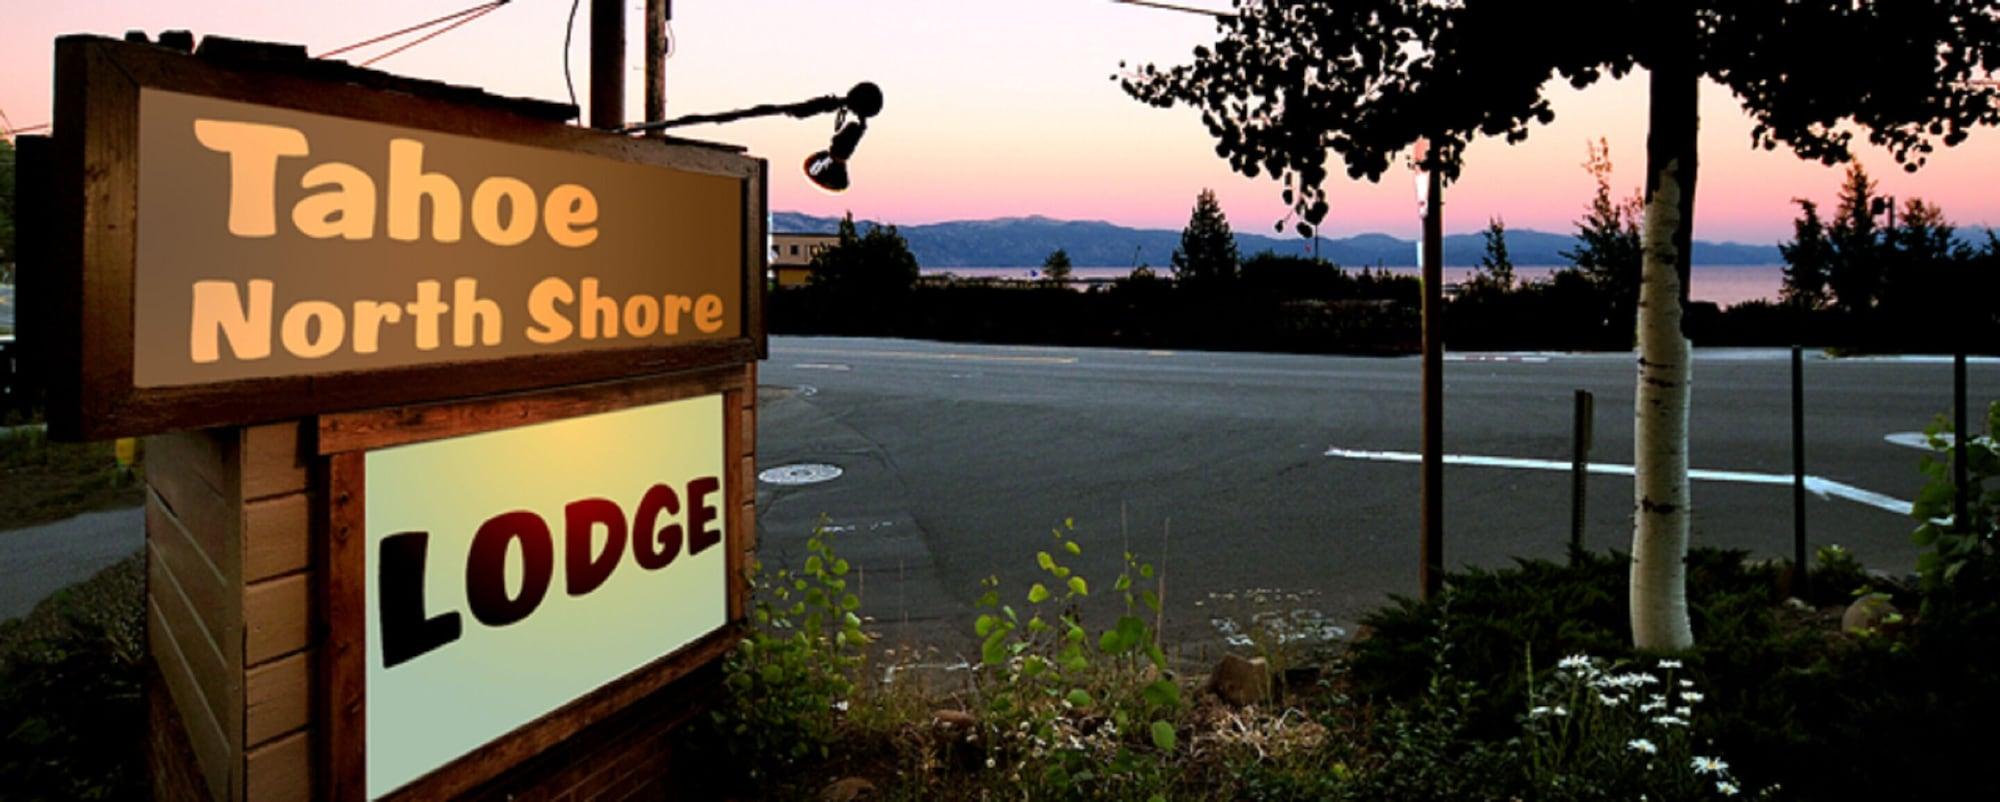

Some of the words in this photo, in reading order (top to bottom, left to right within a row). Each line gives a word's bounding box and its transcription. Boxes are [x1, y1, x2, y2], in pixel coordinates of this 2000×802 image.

[194, 119, 599, 247] Tahoe
[190, 278, 503, 363] North
[525, 277, 724, 344] Shore
[378, 476, 722, 669] LODGE
